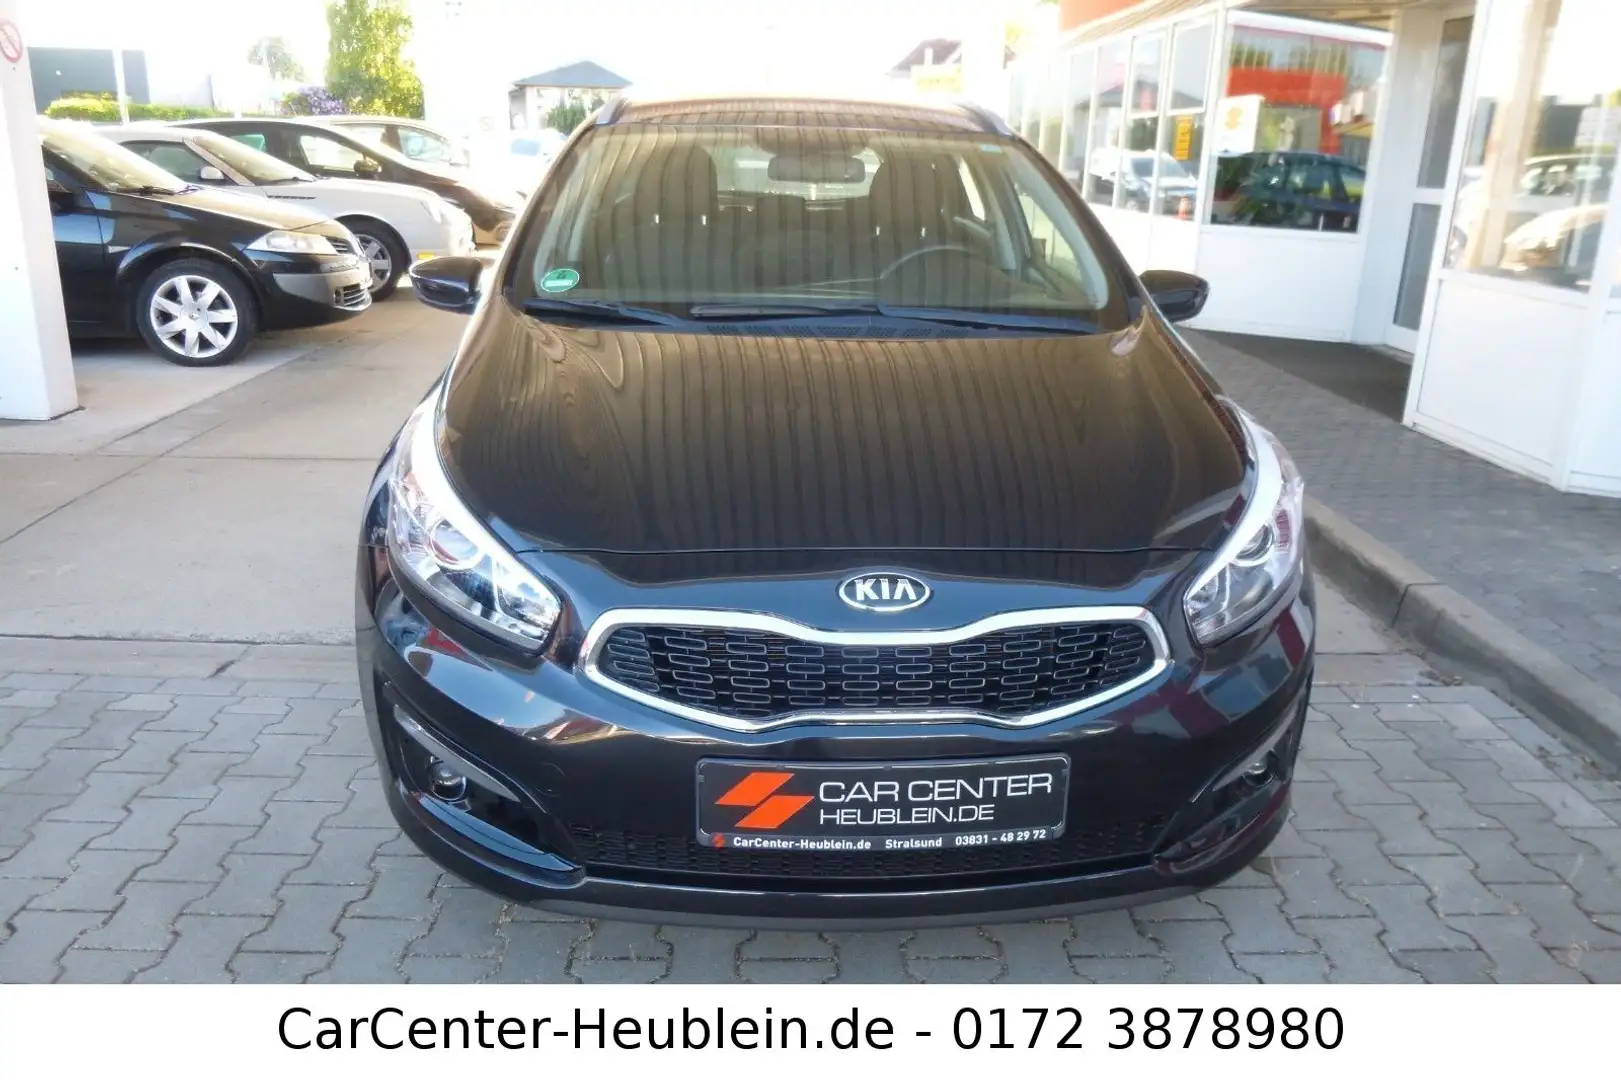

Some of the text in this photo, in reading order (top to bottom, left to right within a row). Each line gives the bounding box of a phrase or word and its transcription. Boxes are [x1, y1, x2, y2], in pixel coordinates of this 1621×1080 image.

[854, 577, 917, 602] KIA
[819, 773, 1053, 803] CAR CENTER
[819, 804, 995, 825] HEUBLEIN.DE
[733, 836, 872, 850] CarCenter-Heublein.de
[885, 837, 942, 849] Stralsund
[955, 834, 988, 846] 03831
[1000, 832, 1014, 842] 48
[1017, 831, 1030, 841] 29
[1032, 829, 1046, 839] 72
